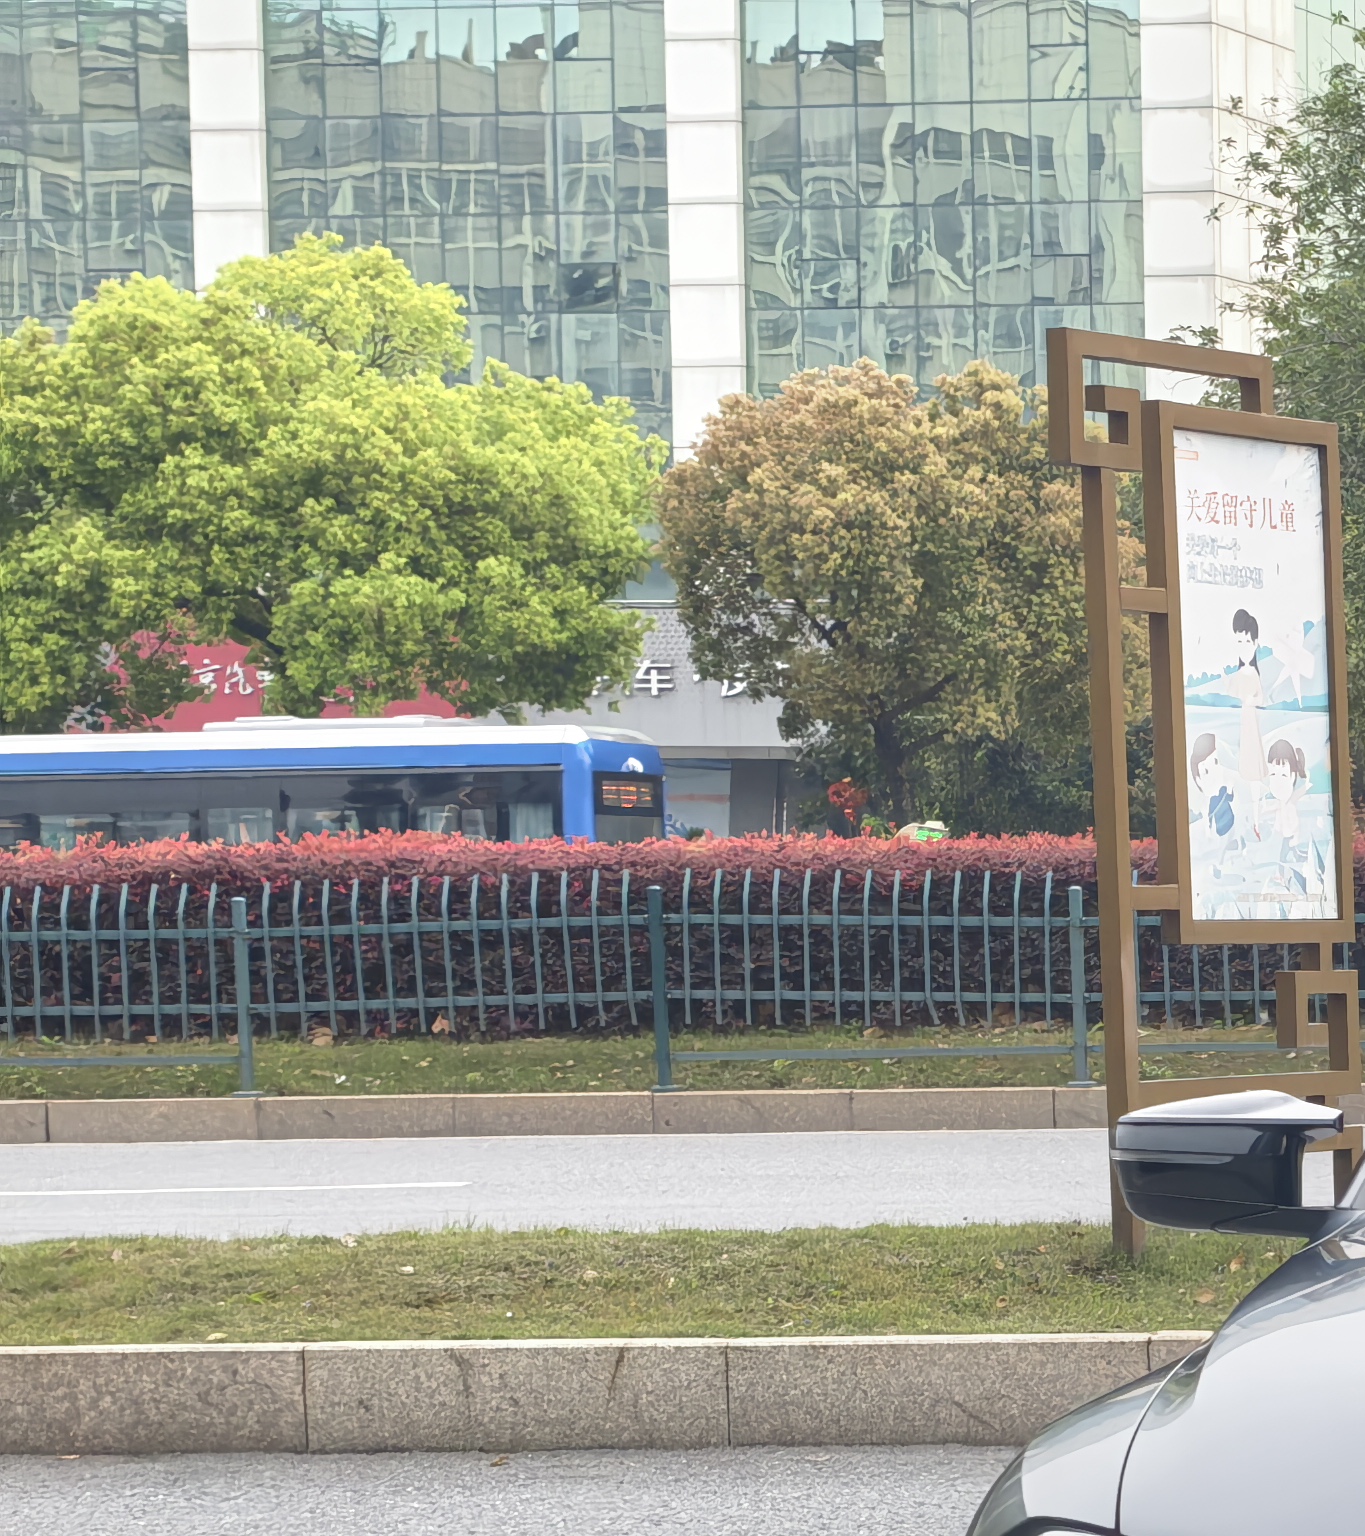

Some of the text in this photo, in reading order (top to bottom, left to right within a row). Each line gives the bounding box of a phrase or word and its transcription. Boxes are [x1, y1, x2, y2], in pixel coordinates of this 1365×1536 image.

[1184, 487, 1297, 533] 关爱留守儿童
